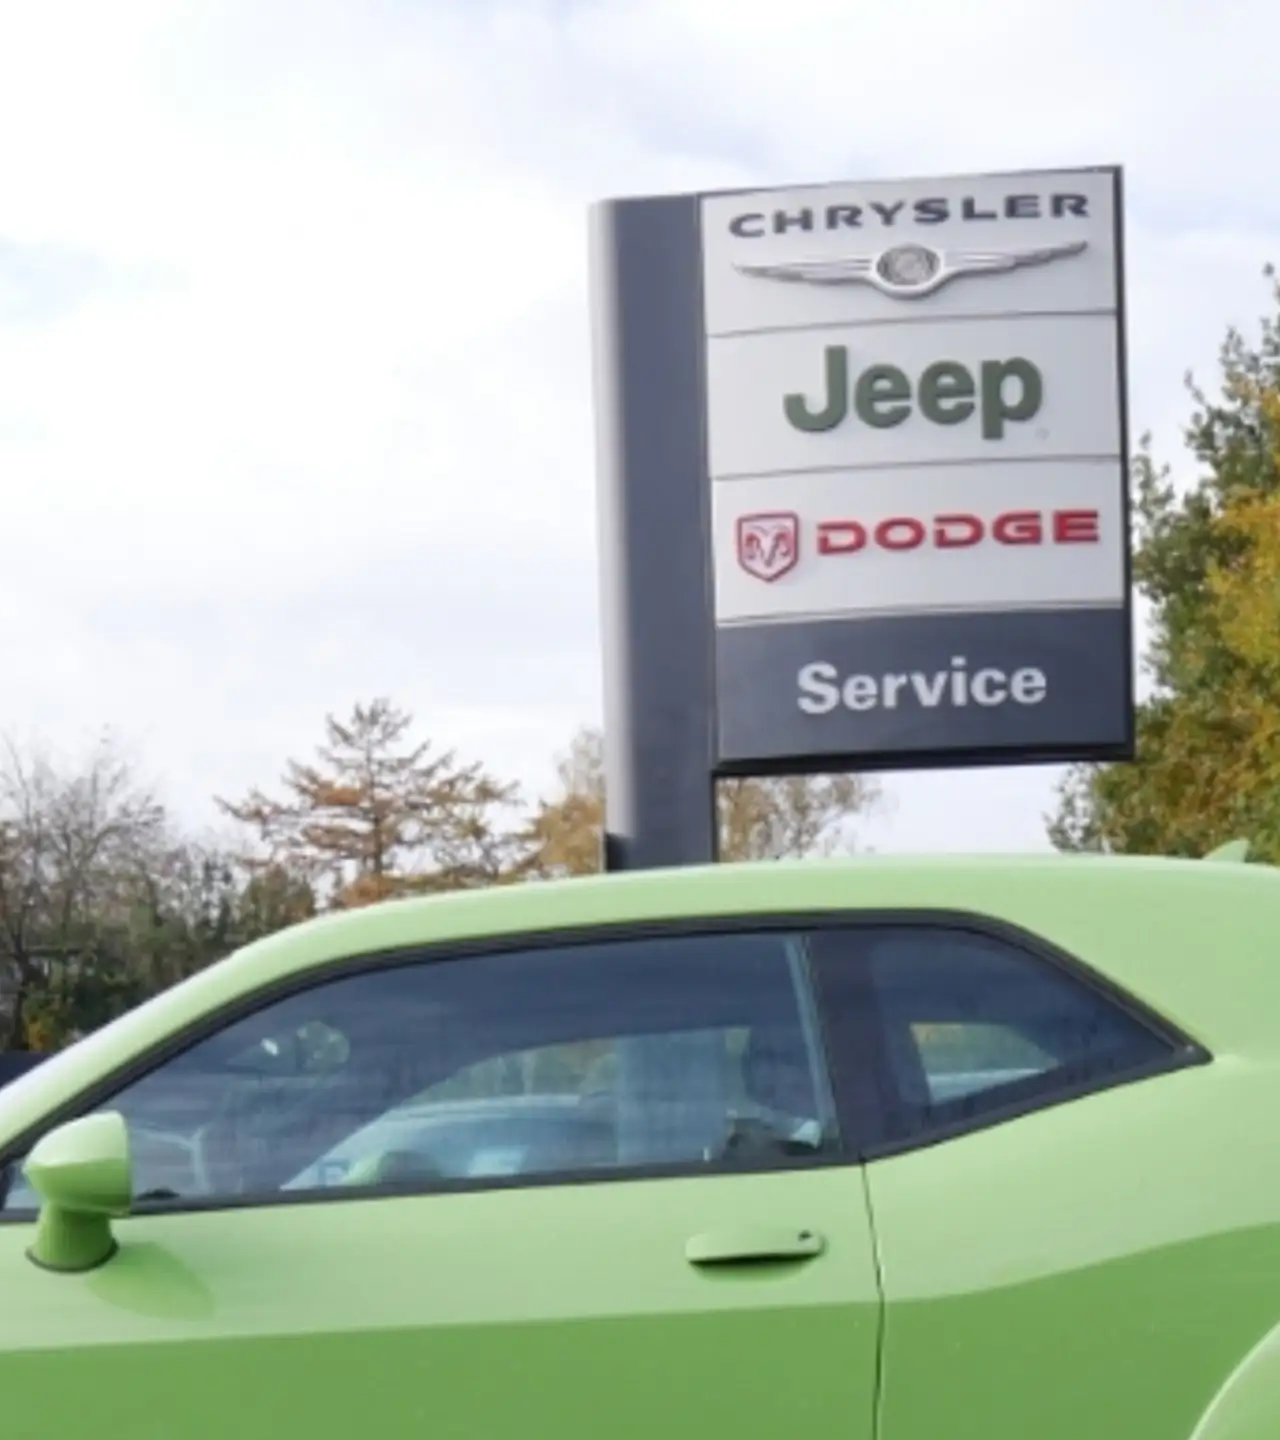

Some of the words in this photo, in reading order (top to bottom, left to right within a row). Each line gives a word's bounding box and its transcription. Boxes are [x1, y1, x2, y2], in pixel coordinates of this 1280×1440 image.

[729, 192, 1089, 238] CHRYSLER
[782, 344, 1043, 440] Jeep
[815, 509, 1101, 556] DODGE
[796, 656, 1048, 714] Service
